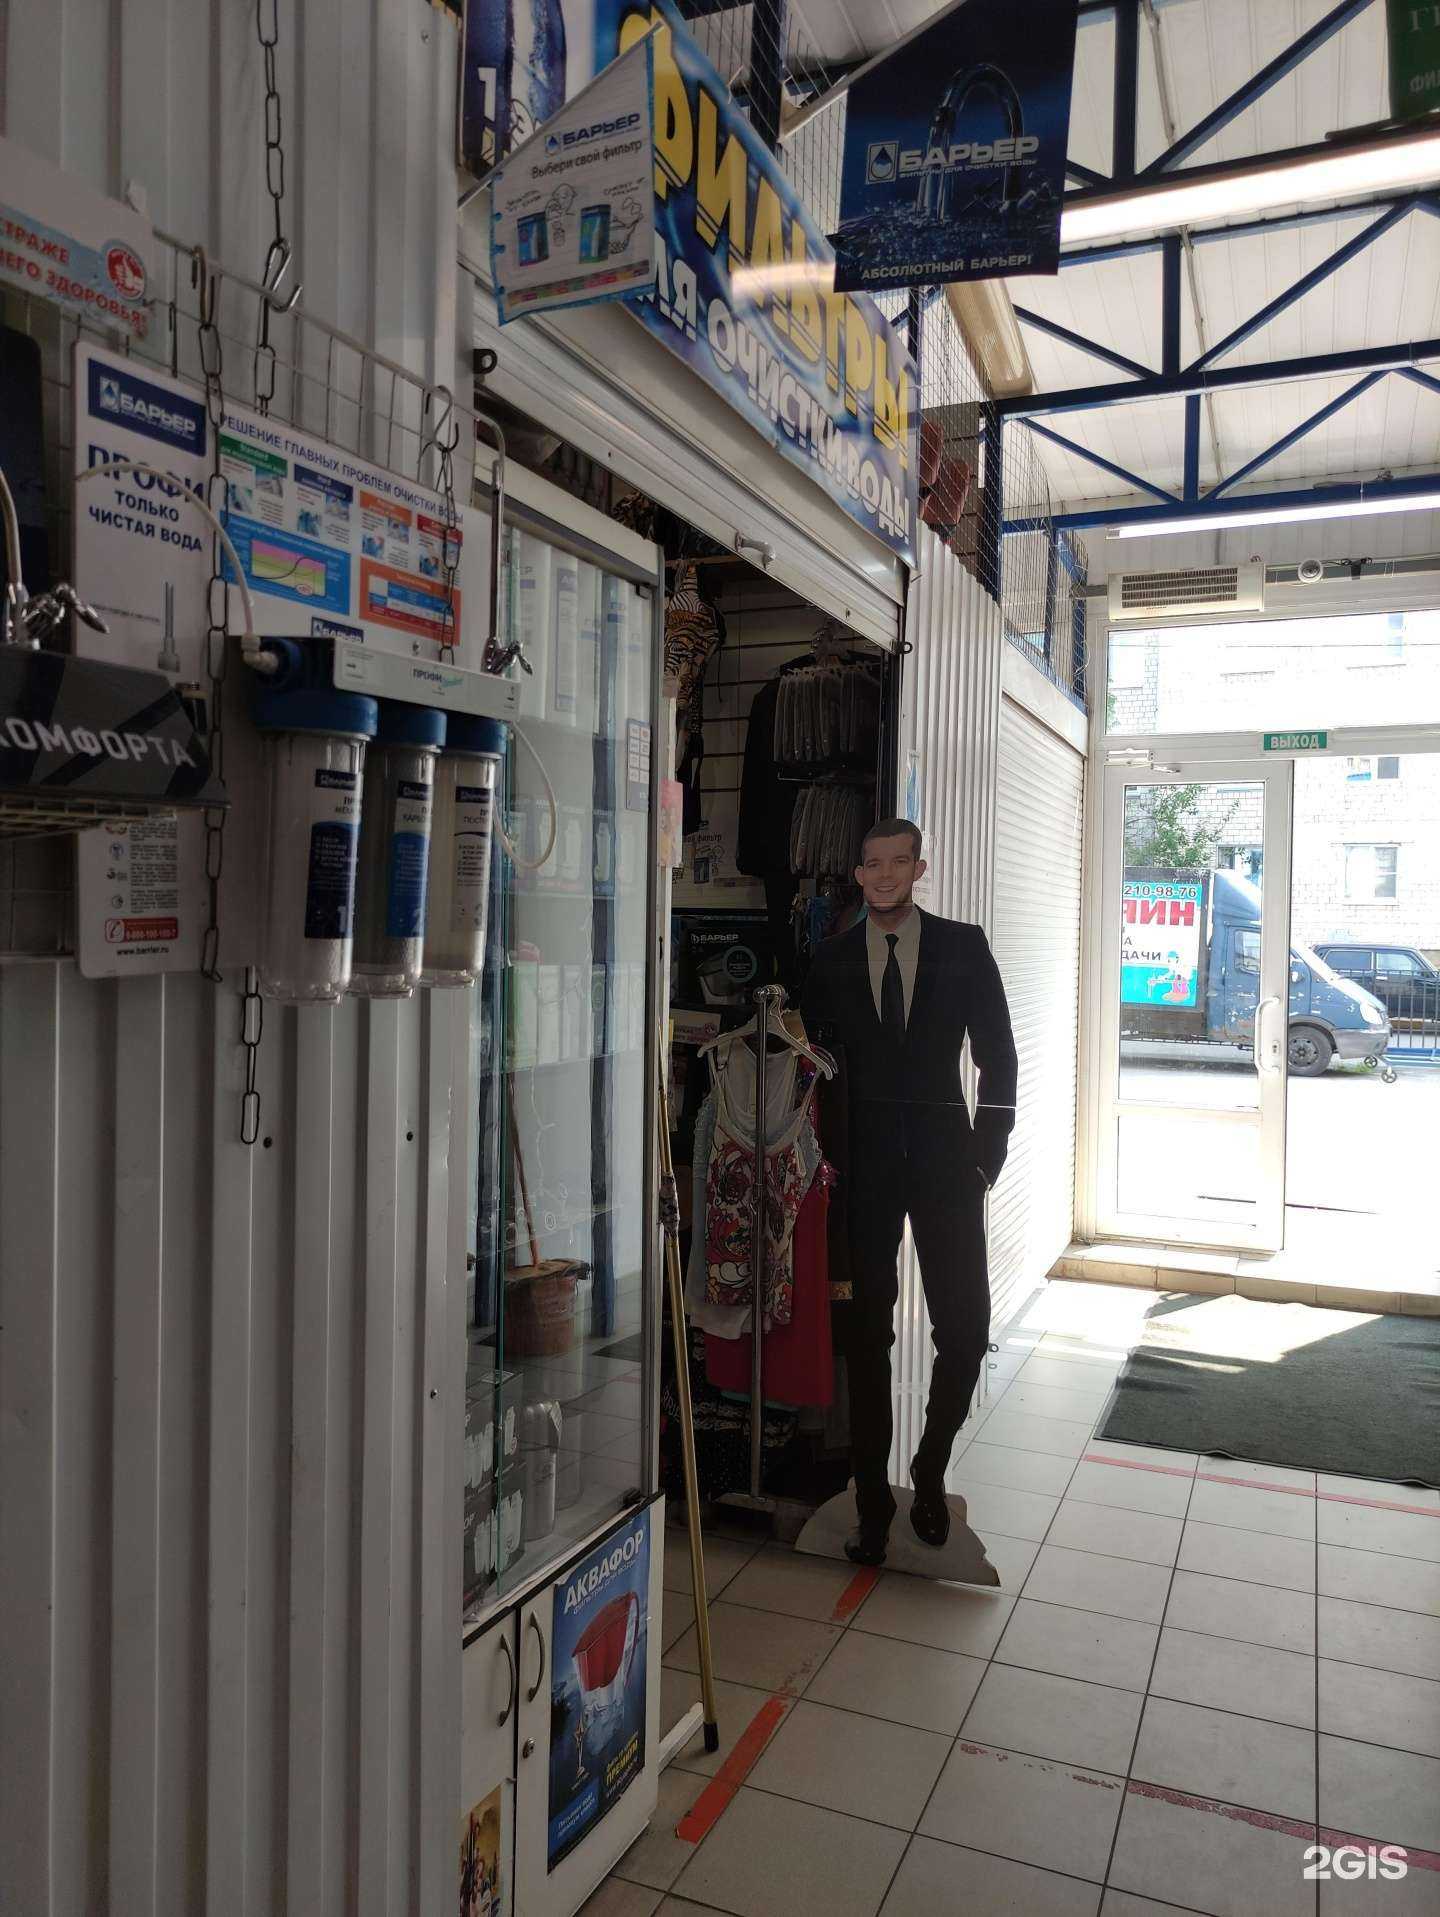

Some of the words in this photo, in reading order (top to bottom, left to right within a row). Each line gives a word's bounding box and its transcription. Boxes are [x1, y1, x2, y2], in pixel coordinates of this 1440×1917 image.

[563, 113, 640, 145] БАРЬЕР
[531, 157, 574, 179] Выбери
[575, 152, 600, 169] свой
[602, 140, 642, 161] фильтр
[900, 136, 1040, 169] БАРЬЕР
[860, 258, 964, 281] АБСОЛЮТНЫЙ
[970, 254, 1033, 270] БАРЬЕР!
[120, 391, 196, 433] БАРЬЕР
[707, 298, 843, 485] ОЧИСТКИ
[847, 441, 910, 545] ВОДЫ
[284, 440, 340, 471] ГЛАВНЫХ
[342, 464, 392, 494] ПРОБЛЕМ
[394, 486, 436, 512] ОЧИСТКИ
[115, 490, 179, 522] ТОЛЬКО
[89, 506, 155, 538] ЧИСТАЯ
[160, 527, 202, 552] ВОДА
[1270, 734, 1320, 750] ВЫХОД
[1124, 885, 1197, 897] 210-98-76
[700, 933, 739, 943] БАРЬЕР
[563, 1528, 644, 1615] АКВАФОР
